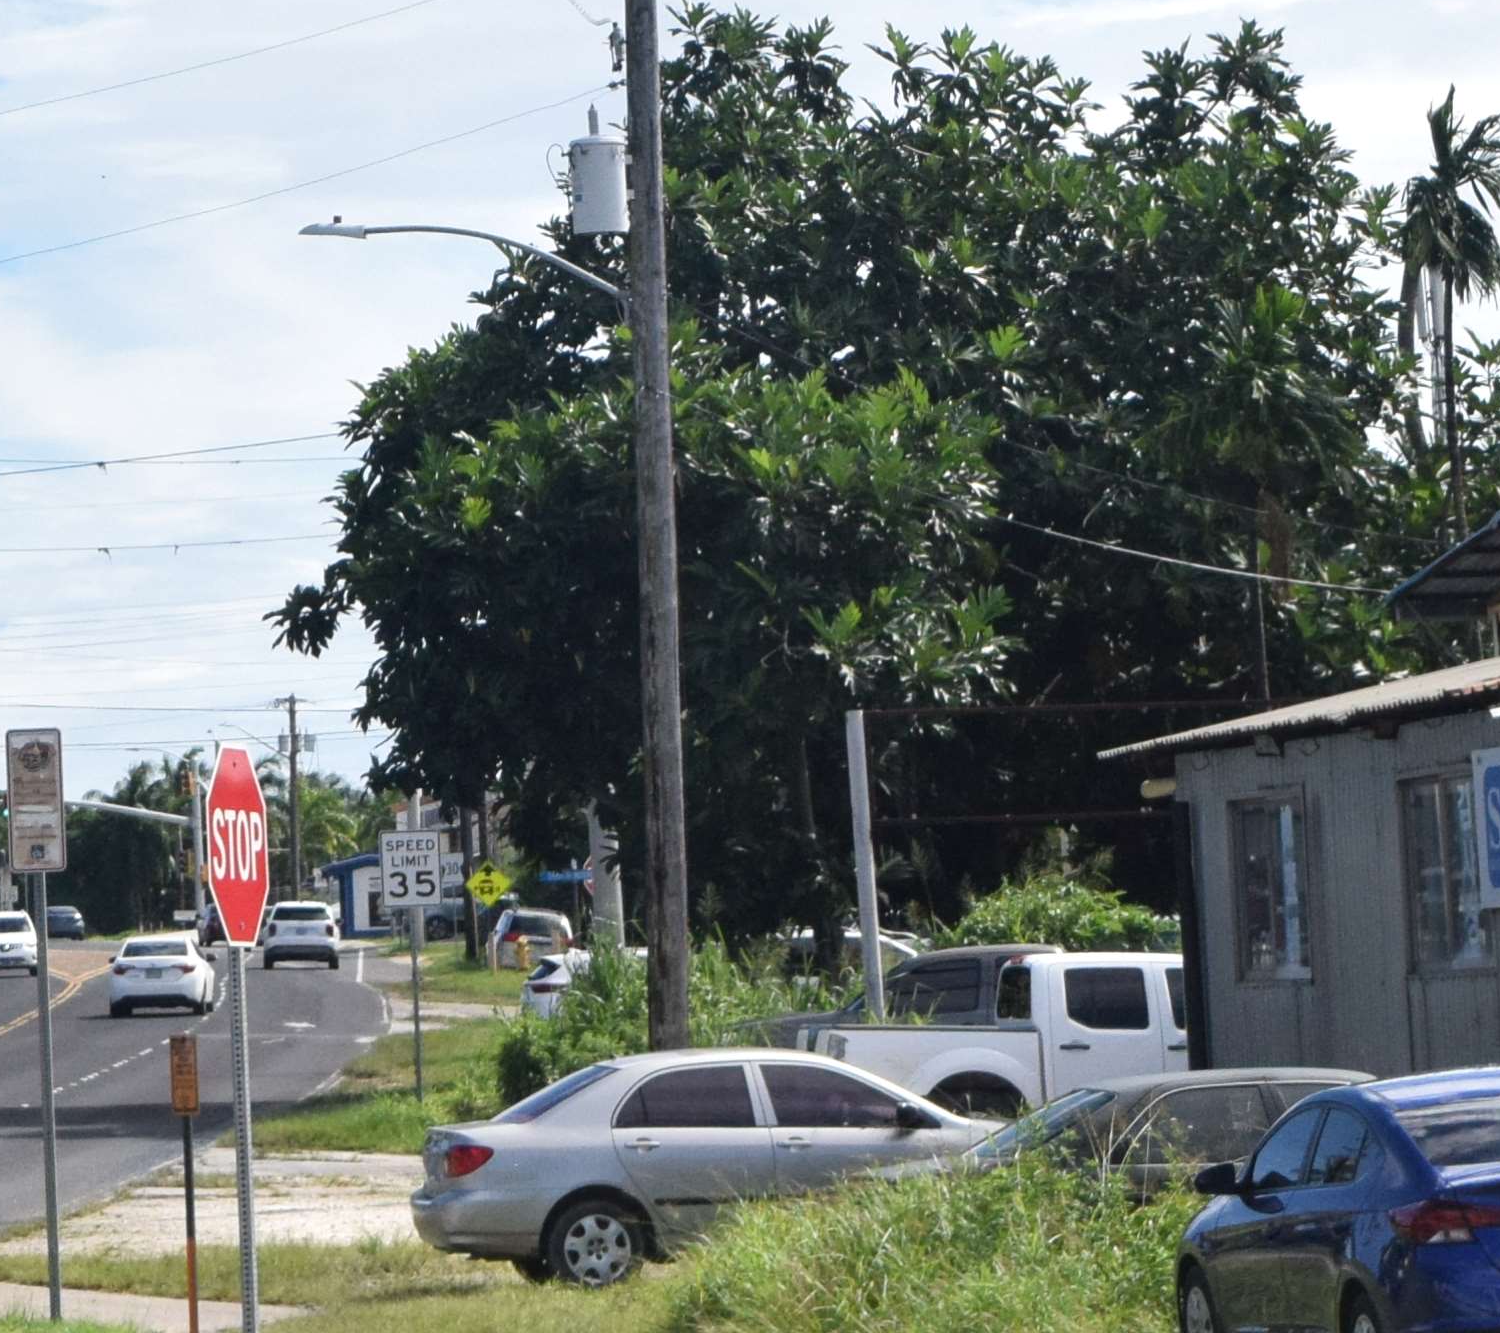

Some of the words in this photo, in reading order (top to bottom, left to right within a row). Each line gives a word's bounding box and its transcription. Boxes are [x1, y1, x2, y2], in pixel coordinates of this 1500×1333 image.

[212, 807, 263, 882] STOP
[385, 838, 435, 852] SPEED
[391, 854, 429, 868] LIMIT
[389, 870, 436, 898] 35
